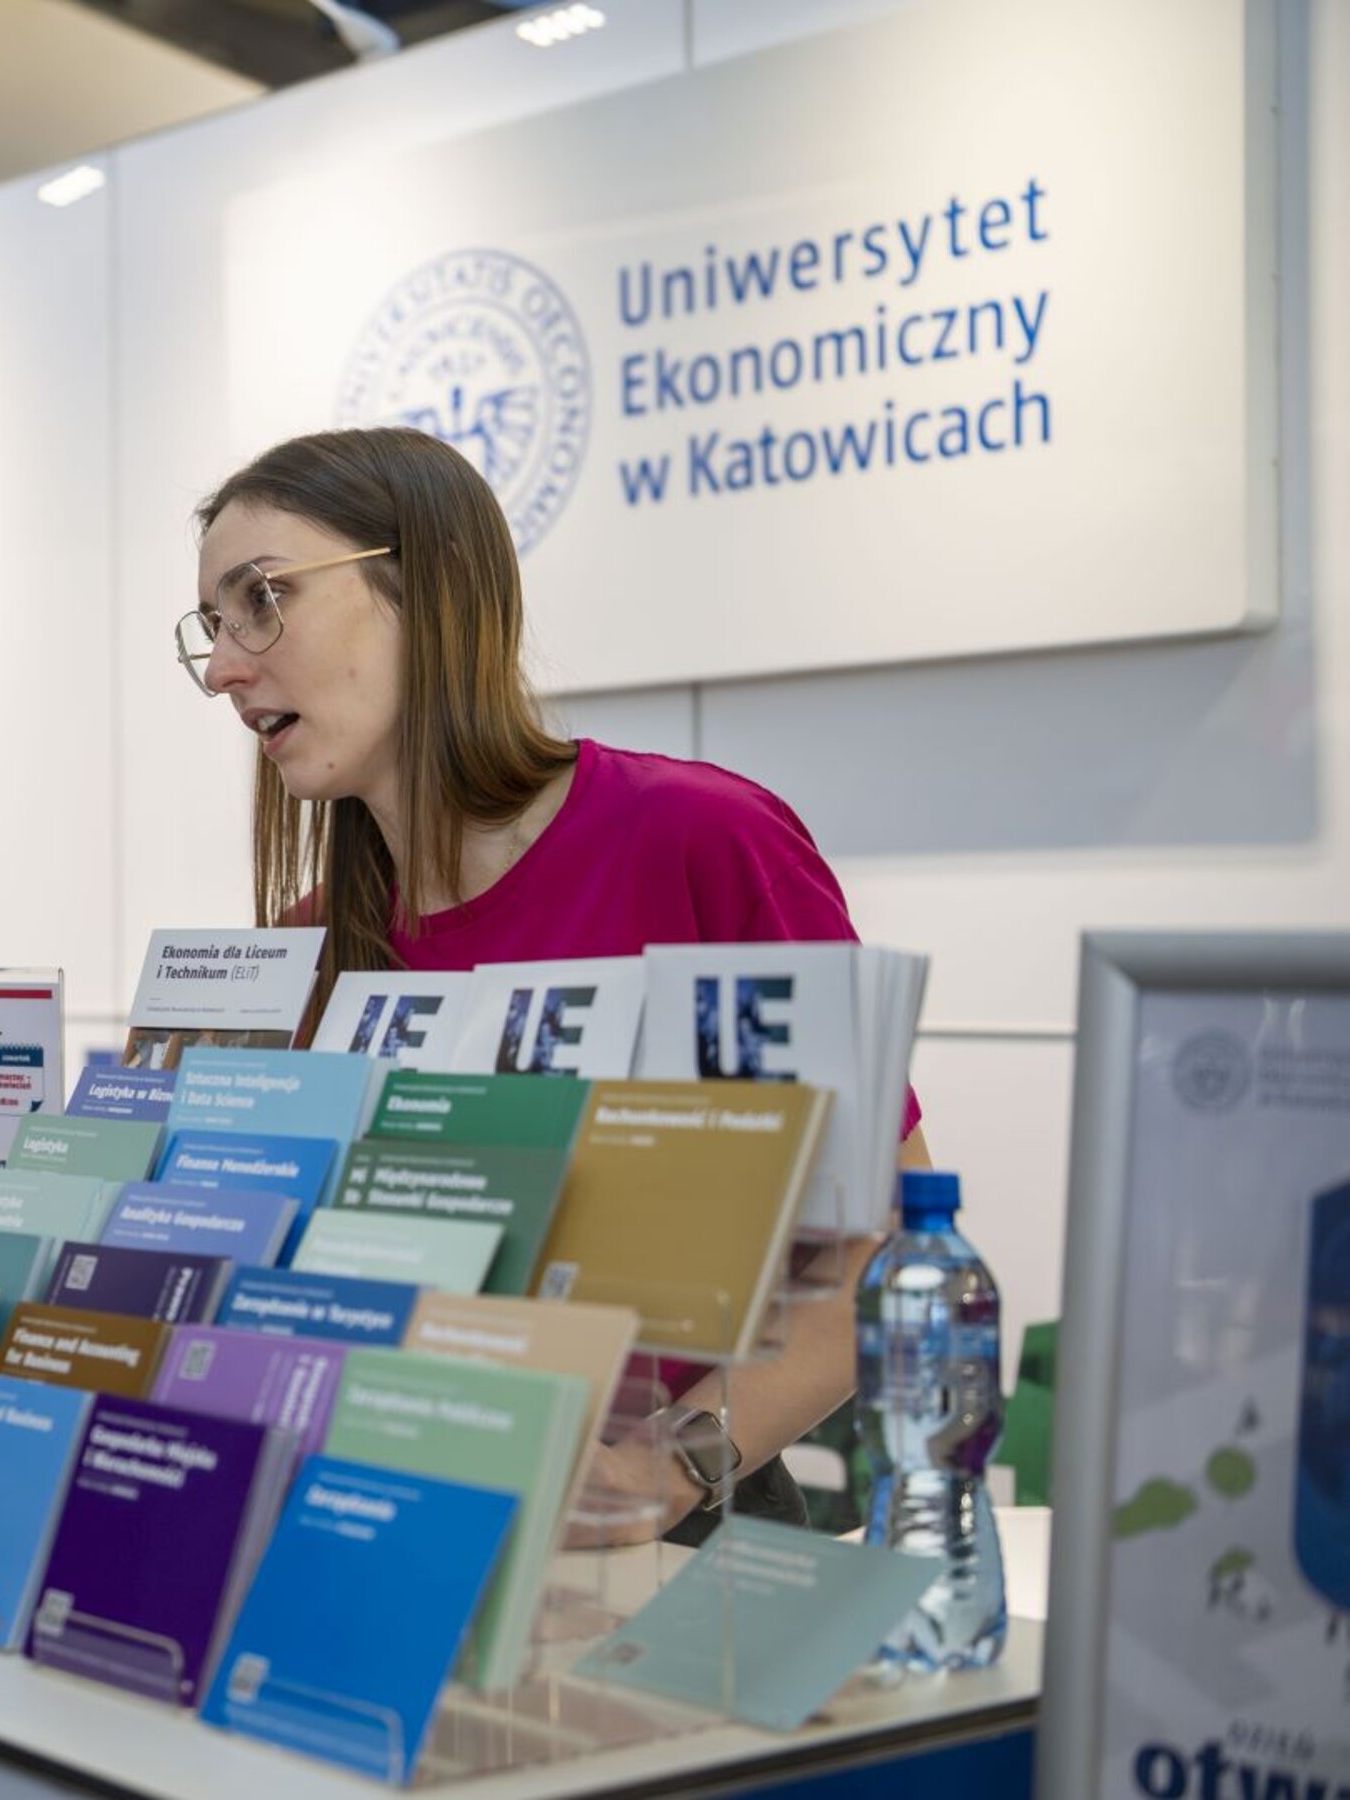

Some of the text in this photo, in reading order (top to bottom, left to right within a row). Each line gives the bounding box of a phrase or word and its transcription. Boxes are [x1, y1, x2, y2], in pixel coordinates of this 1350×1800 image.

[617, 176, 1049, 328] Uniwersytet
[620, 290, 1049, 418] Ekonomiczny
[619, 378, 1050, 508] w Katowicach
[162, 943, 287, 959] Ekonomia dla Liceum
[165, 964, 228, 980] Technikum
[89, 1083, 136, 1099] Logistyka
[137, 1090, 148, 1100] w
[23, 1135, 69, 1154] Logistyka
[1134, 1736, 1350, 1800] otw
